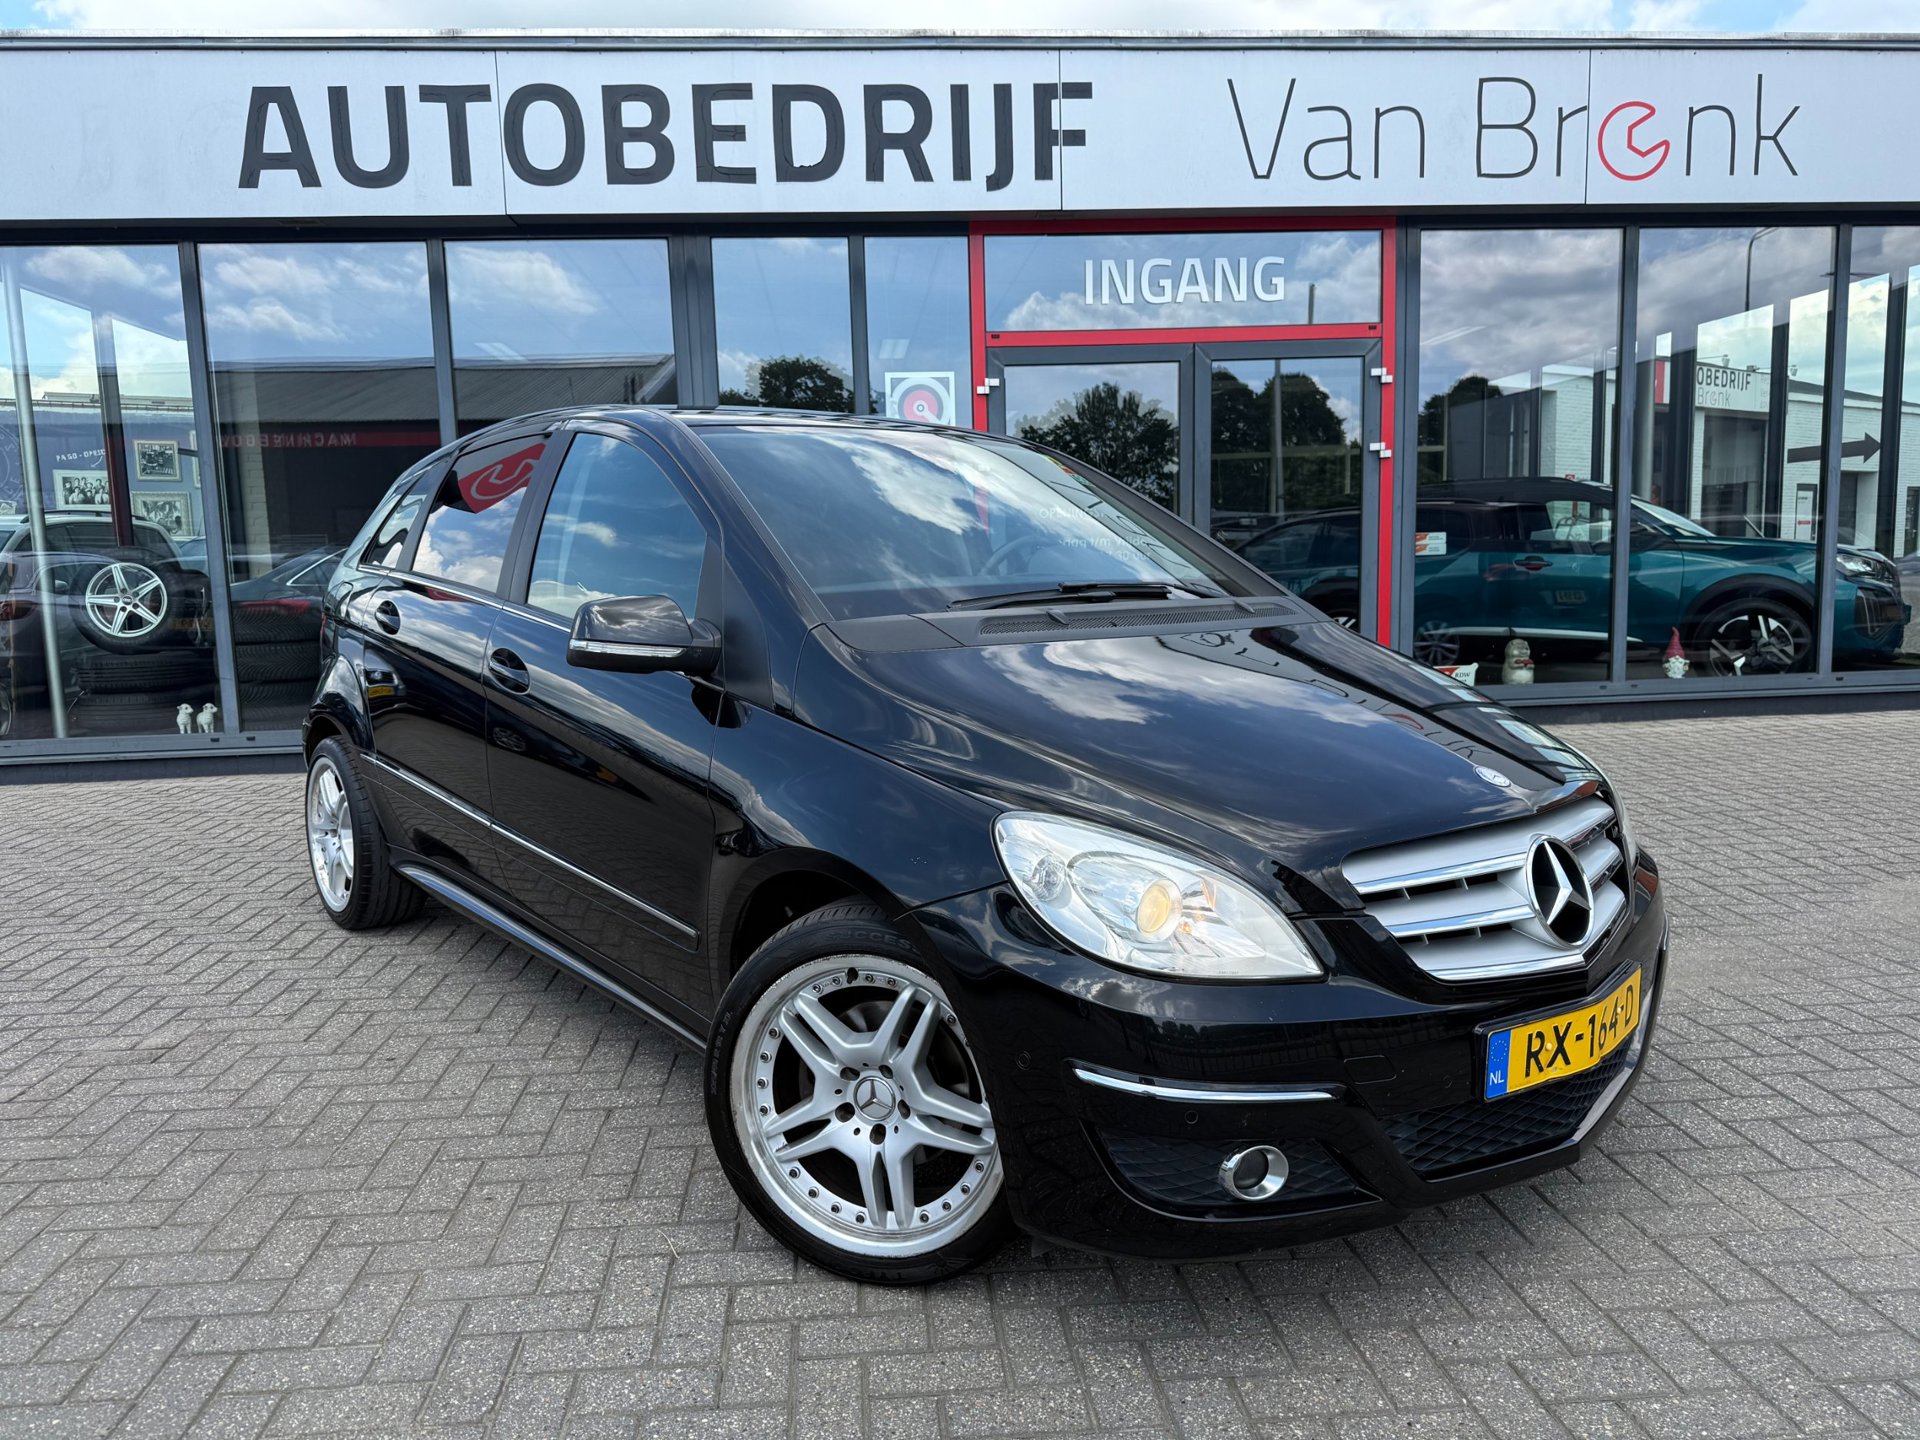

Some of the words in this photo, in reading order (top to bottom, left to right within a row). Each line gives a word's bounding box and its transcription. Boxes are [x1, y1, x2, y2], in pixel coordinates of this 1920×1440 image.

[238, 81, 1093, 193] AUTOBEDRIJF
[1226, 77, 1426, 181] Van
[1084, 256, 1286, 305] INGANG
[1524, 984, 1634, 1078] RX-164-D
[1489, 1070, 1505, 1086] NL
